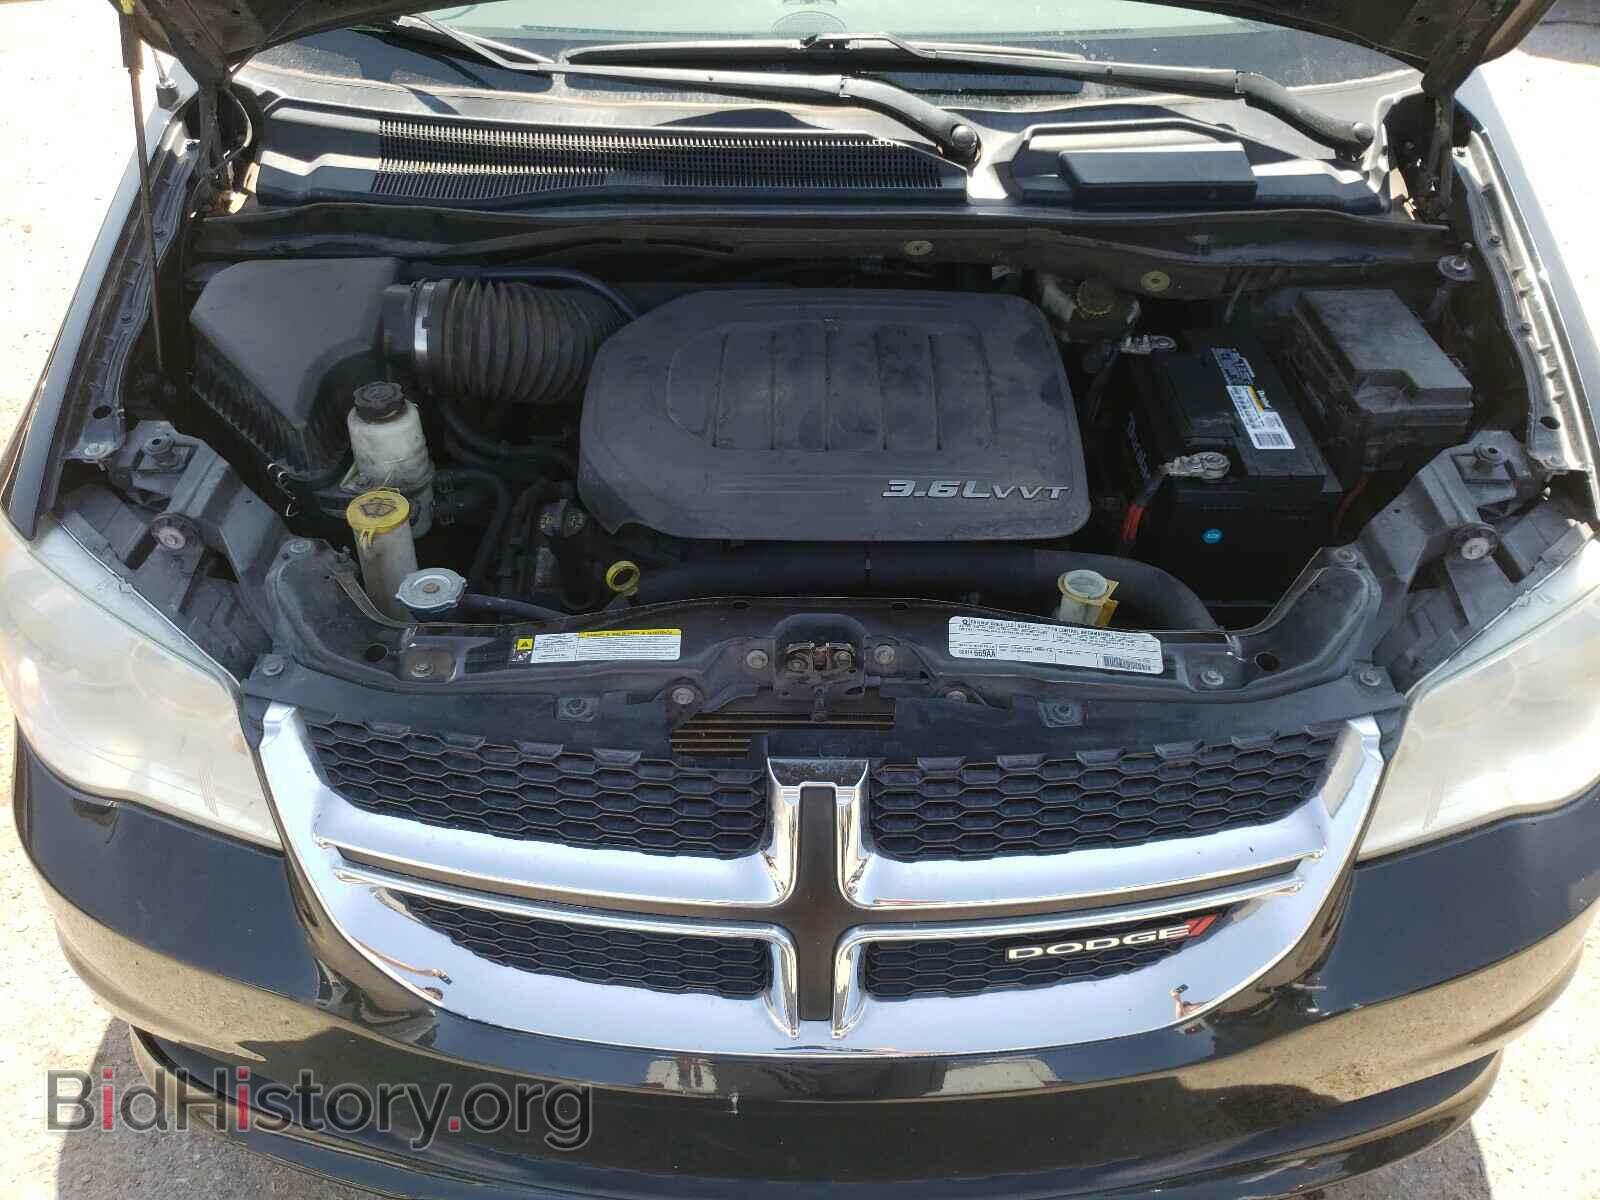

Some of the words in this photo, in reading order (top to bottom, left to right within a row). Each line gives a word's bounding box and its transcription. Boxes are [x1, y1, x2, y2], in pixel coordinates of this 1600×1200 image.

[882, 479, 991, 498] 3.6L
[992, 485, 1070, 500] VVT
[1007, 925, 1191, 960] DODGE
